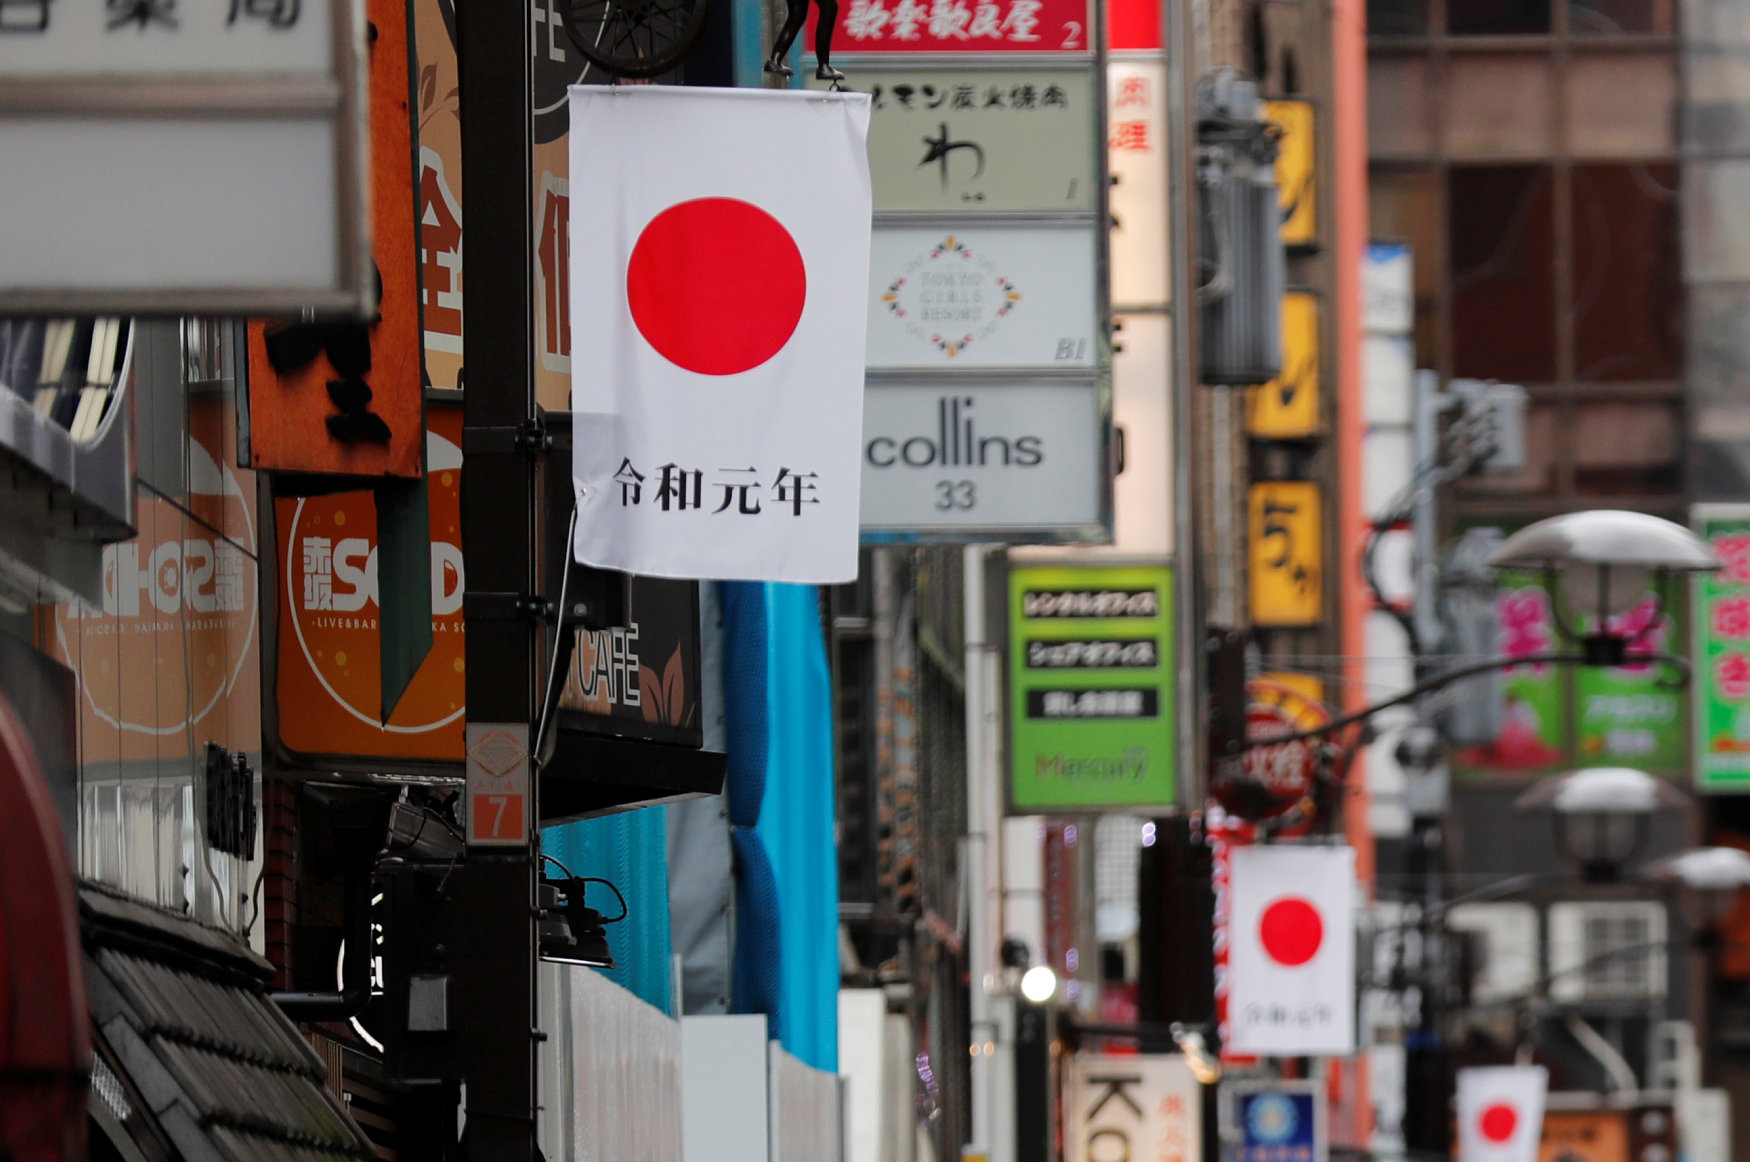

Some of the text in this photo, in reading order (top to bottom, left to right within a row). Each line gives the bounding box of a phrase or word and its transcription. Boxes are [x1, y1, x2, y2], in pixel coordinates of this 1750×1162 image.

[1061, 21, 1081, 48] 2
[866, 397, 1044, 468] collins
[611, 456, 821, 517] 令和元年
[936, 480, 977, 511] 33
[1034, 753, 1149, 781] Mercury
[489, 796, 507, 837] 7
